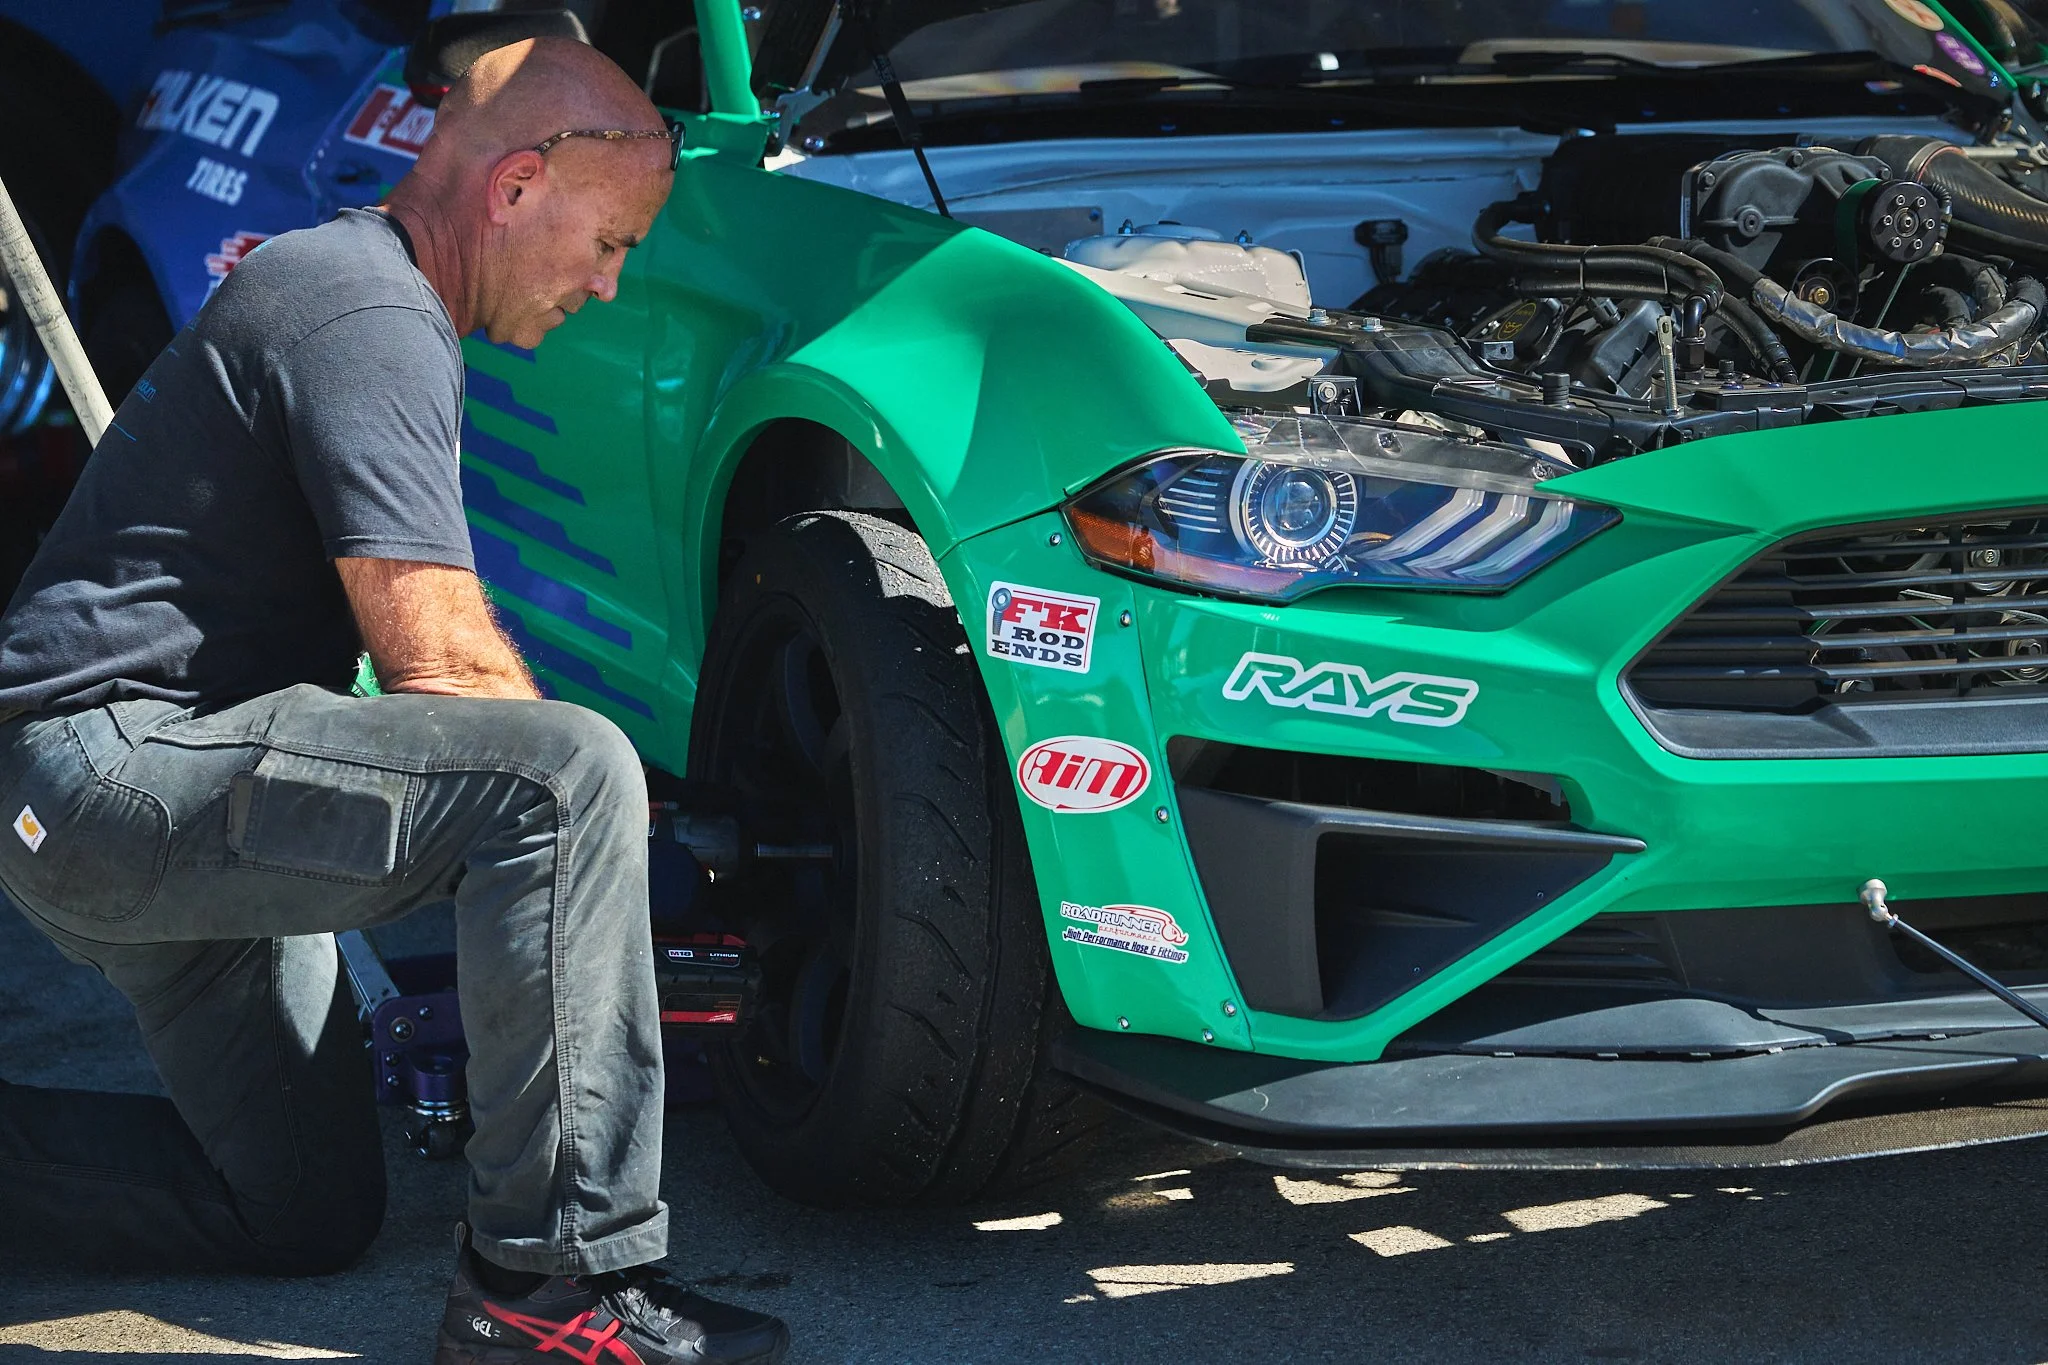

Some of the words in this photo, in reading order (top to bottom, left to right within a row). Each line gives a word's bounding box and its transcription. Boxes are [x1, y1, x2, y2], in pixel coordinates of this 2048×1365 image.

[186, 157, 249, 206] TIRES
[1003, 597, 1089, 634] FK
[991, 639, 1083, 667] ENDS
[1011, 626, 1085, 650] ROD
[1226, 655, 1475, 723] RAYS
[1062, 902, 1162, 935] ROADRUNNER
[1067, 927, 1082, 941] High
[1083, 931, 1131, 951] Performance
[1132, 941, 1149, 955] Hose
[1158, 947, 1187, 962] Fittings
[472, 1316, 492, 1338] GEL
